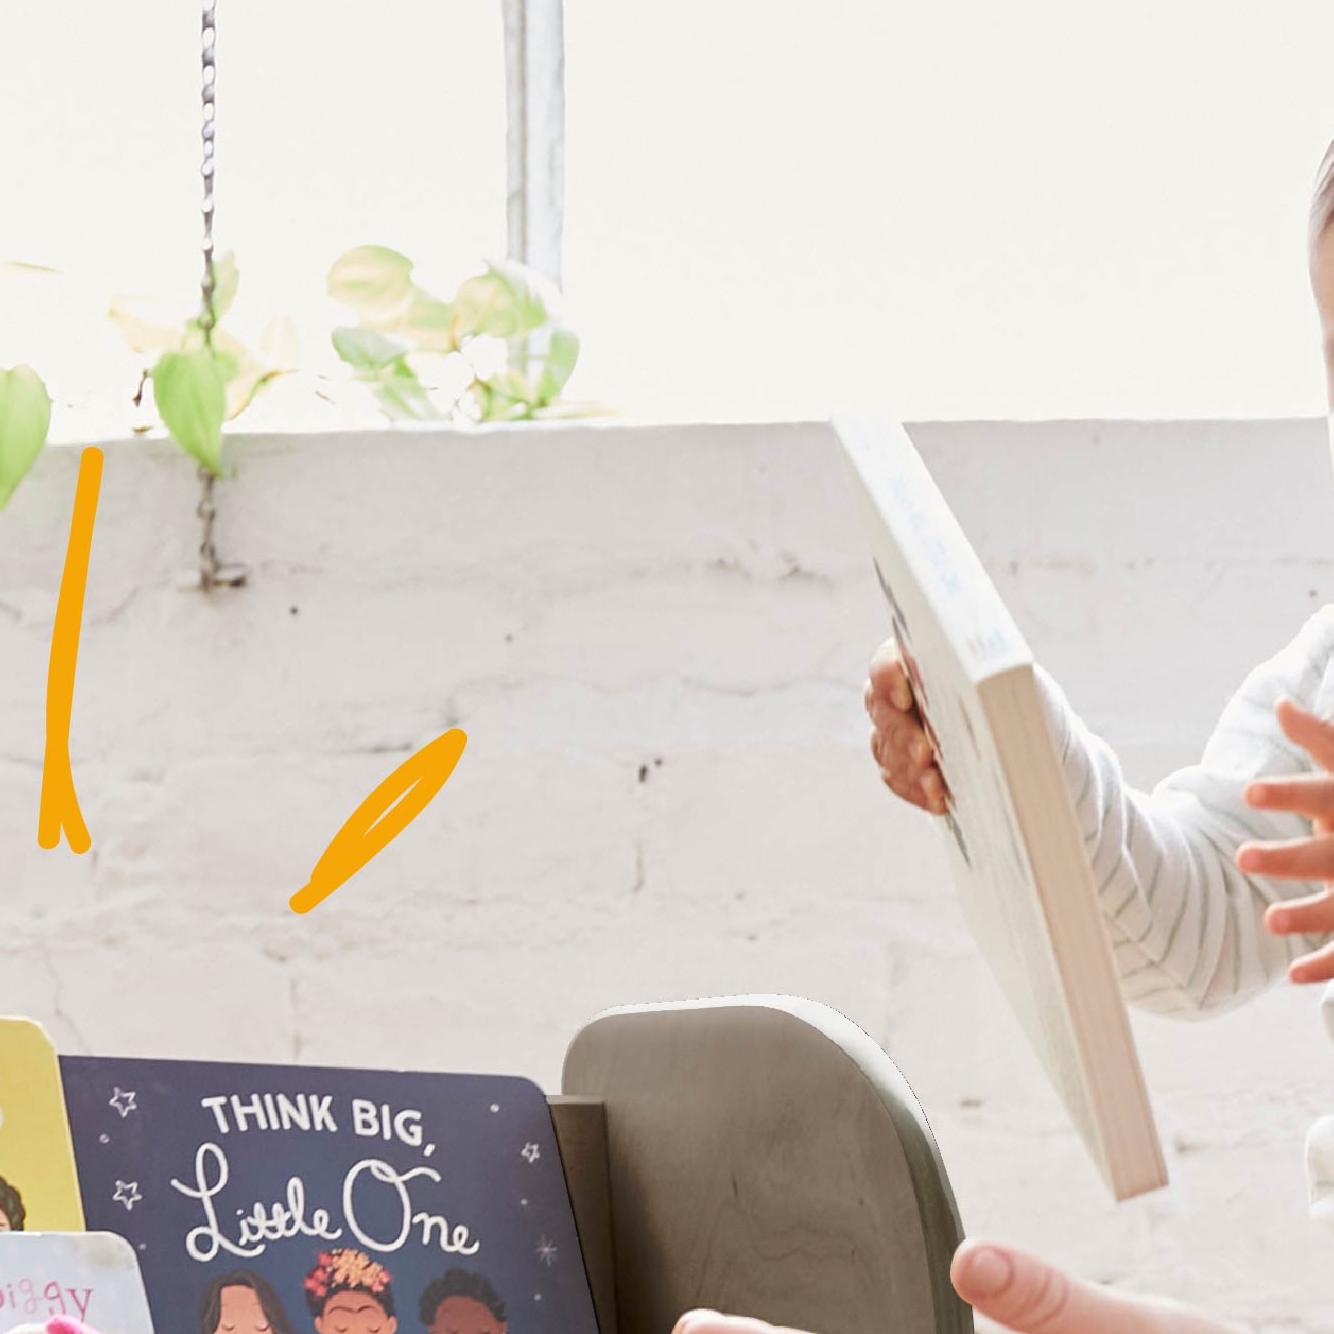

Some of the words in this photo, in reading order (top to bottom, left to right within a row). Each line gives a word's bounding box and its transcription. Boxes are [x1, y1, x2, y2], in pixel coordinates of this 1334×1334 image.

[201, 1092, 338, 1135] THINK
[353, 1098, 436, 1157] BIG,
[170, 1143, 343, 1262] Little
[342, 1159, 480, 1255] One
